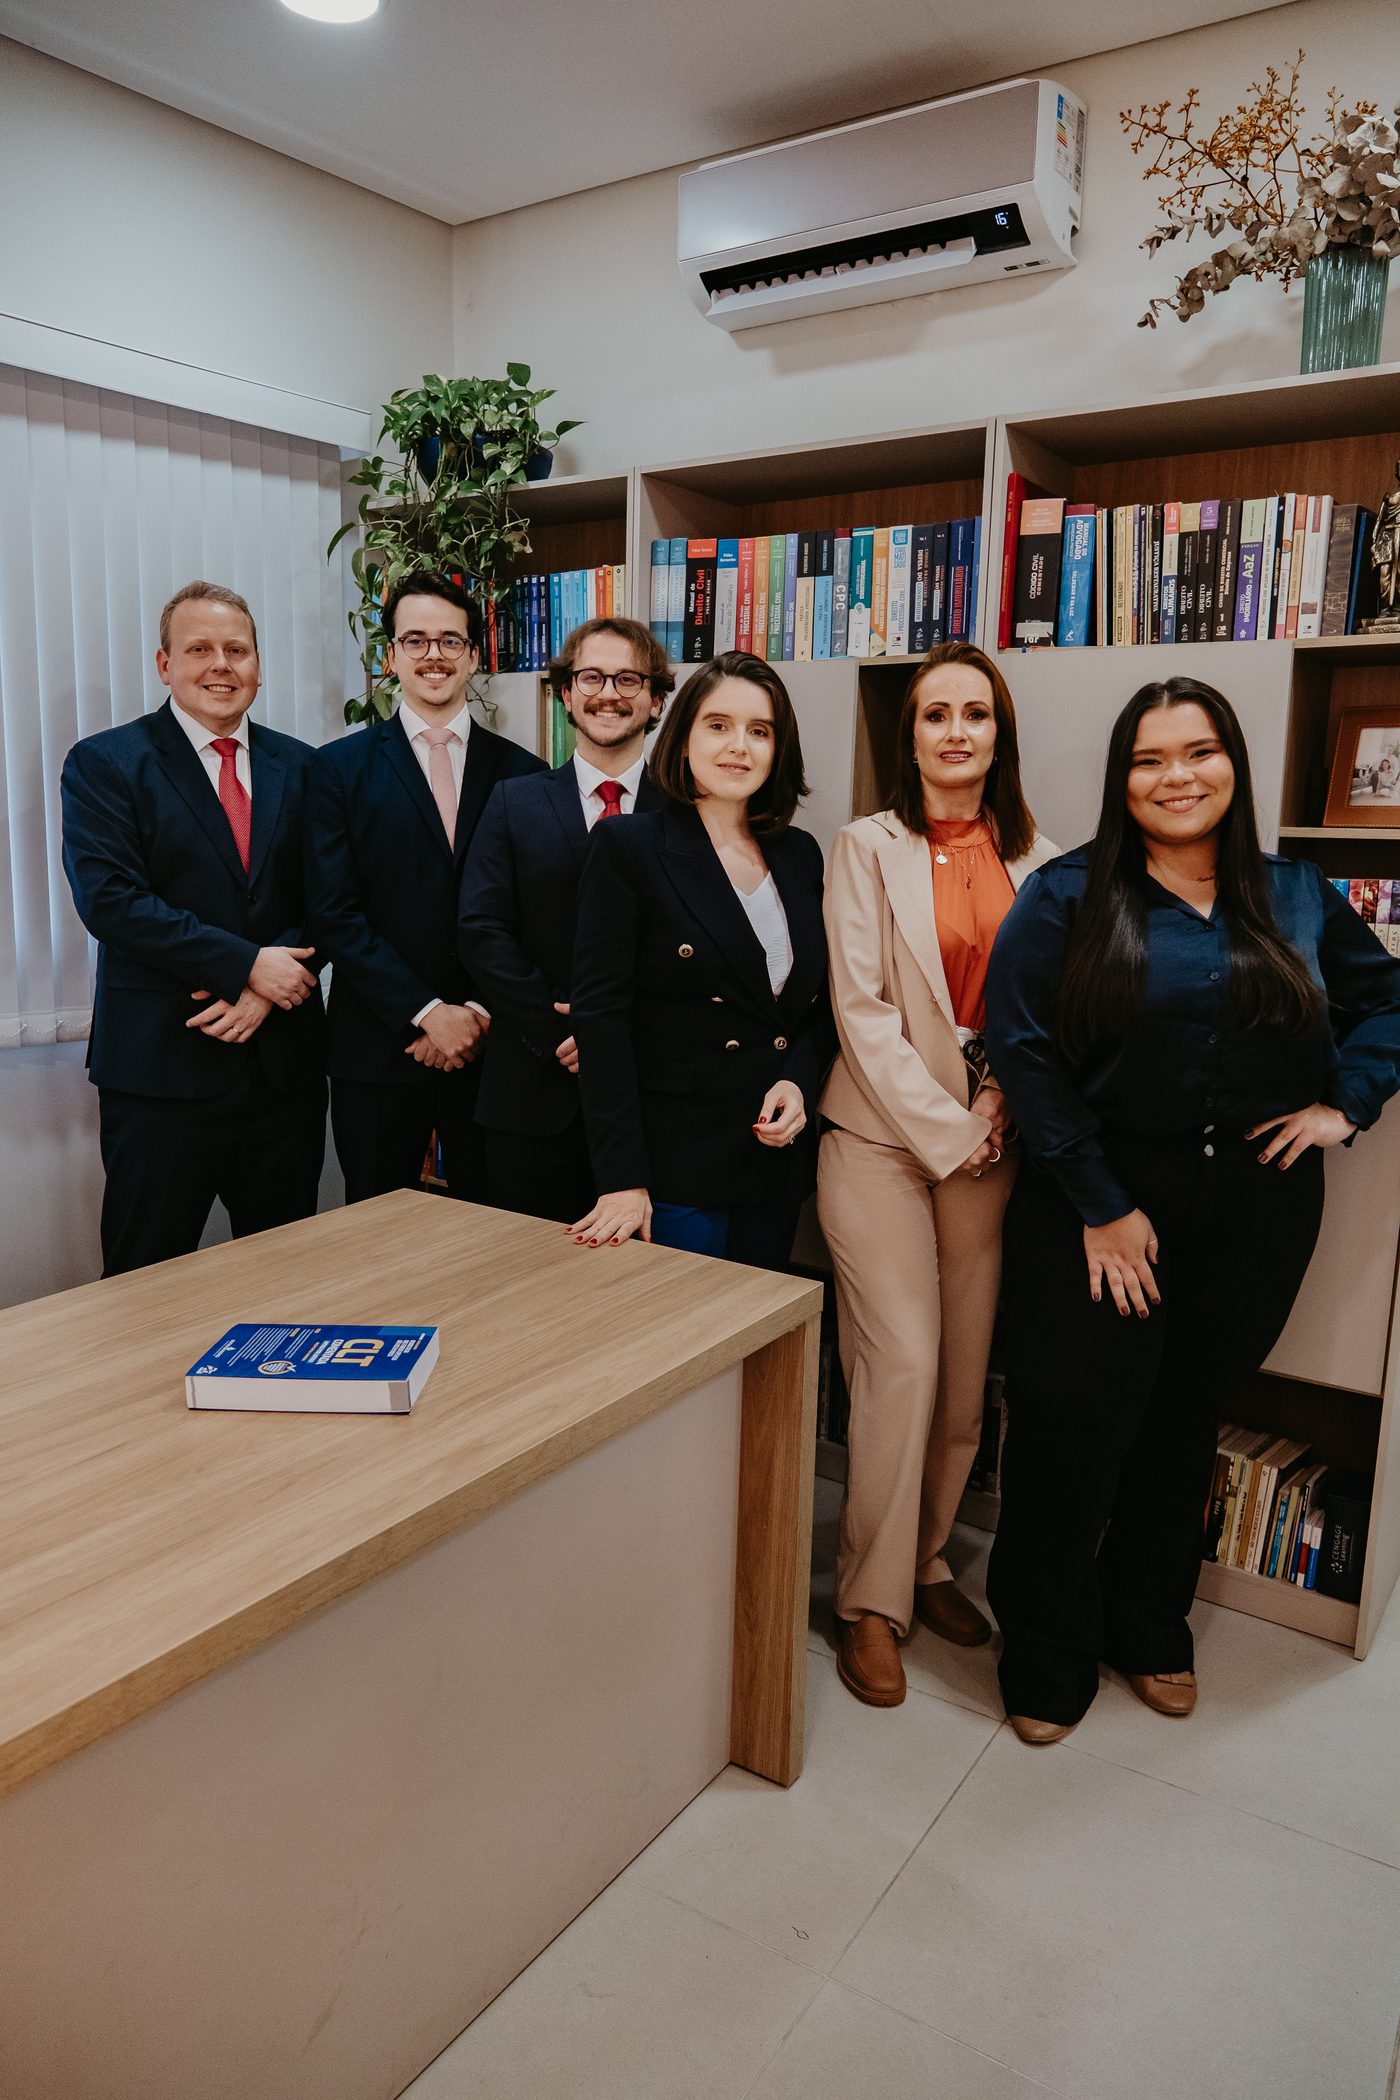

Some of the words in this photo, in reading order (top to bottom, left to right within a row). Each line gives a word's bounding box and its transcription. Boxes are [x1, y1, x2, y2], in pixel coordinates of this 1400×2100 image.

[995, 212, 1007, 225] 16
[1206, 506, 1213, 514] 5
[1074, 519, 1083, 560] ADVOGADO
[1082, 548, 1088, 556] DO
[690, 583, 696, 591] de
[696, 569, 705, 590] Civil
[917, 572, 923, 581] DO
[953, 565, 964, 608] IMOBILIÁRIO
[726, 584, 734, 608] Trabalho
[835, 585, 846, 610] CPC
[1244, 584, 1253, 622] IMOBILIÁRIO
[695, 594, 704, 626] Direito
[743, 605, 751, 635] PROCESSUAL
[758, 605, 766, 634] PROCESSUAL
[953, 609, 962, 634] DIREITO
[331, 1339, 384, 1367] CLT
[1332, 1524, 1342, 1559] CENGAGE
[1341, 1535, 1350, 1562] Learning
